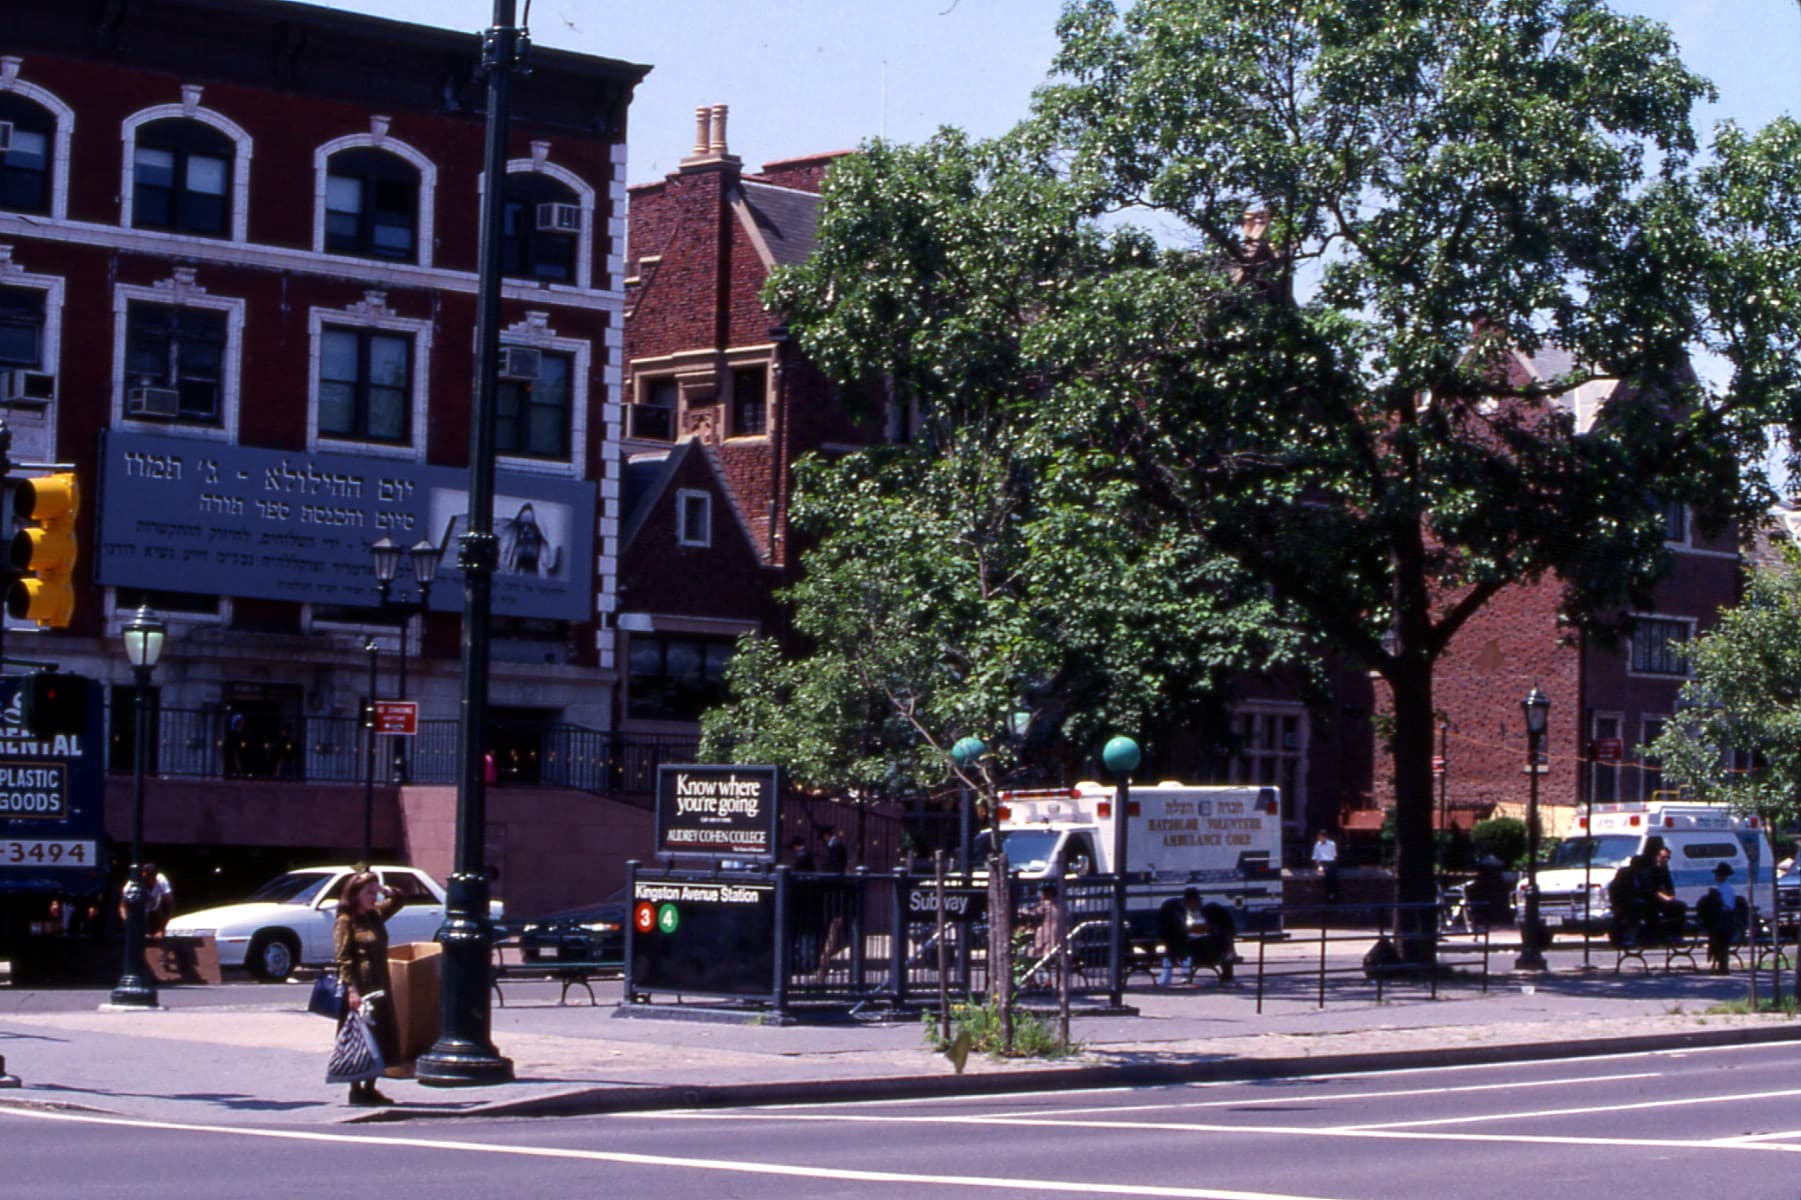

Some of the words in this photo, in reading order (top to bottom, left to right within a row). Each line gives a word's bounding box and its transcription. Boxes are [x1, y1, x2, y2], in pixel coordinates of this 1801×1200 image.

[124, 451, 182, 480] תמוז
[379, 478, 414, 502] יום
[200, 493, 243, 516] תורה
[0, 768, 59, 788] PLASTIC
[677, 774, 717, 796] Know
[719, 774, 760, 797] where
[0, 792, 61, 811] GOODS
[676, 796, 718, 816] you're
[635, 885, 680, 902] Kingston
[681, 887, 719, 901] Avenue
[720, 887, 759, 902] Station
[640, 908, 651, 927] 3
[662, 909, 674, 927] 4
